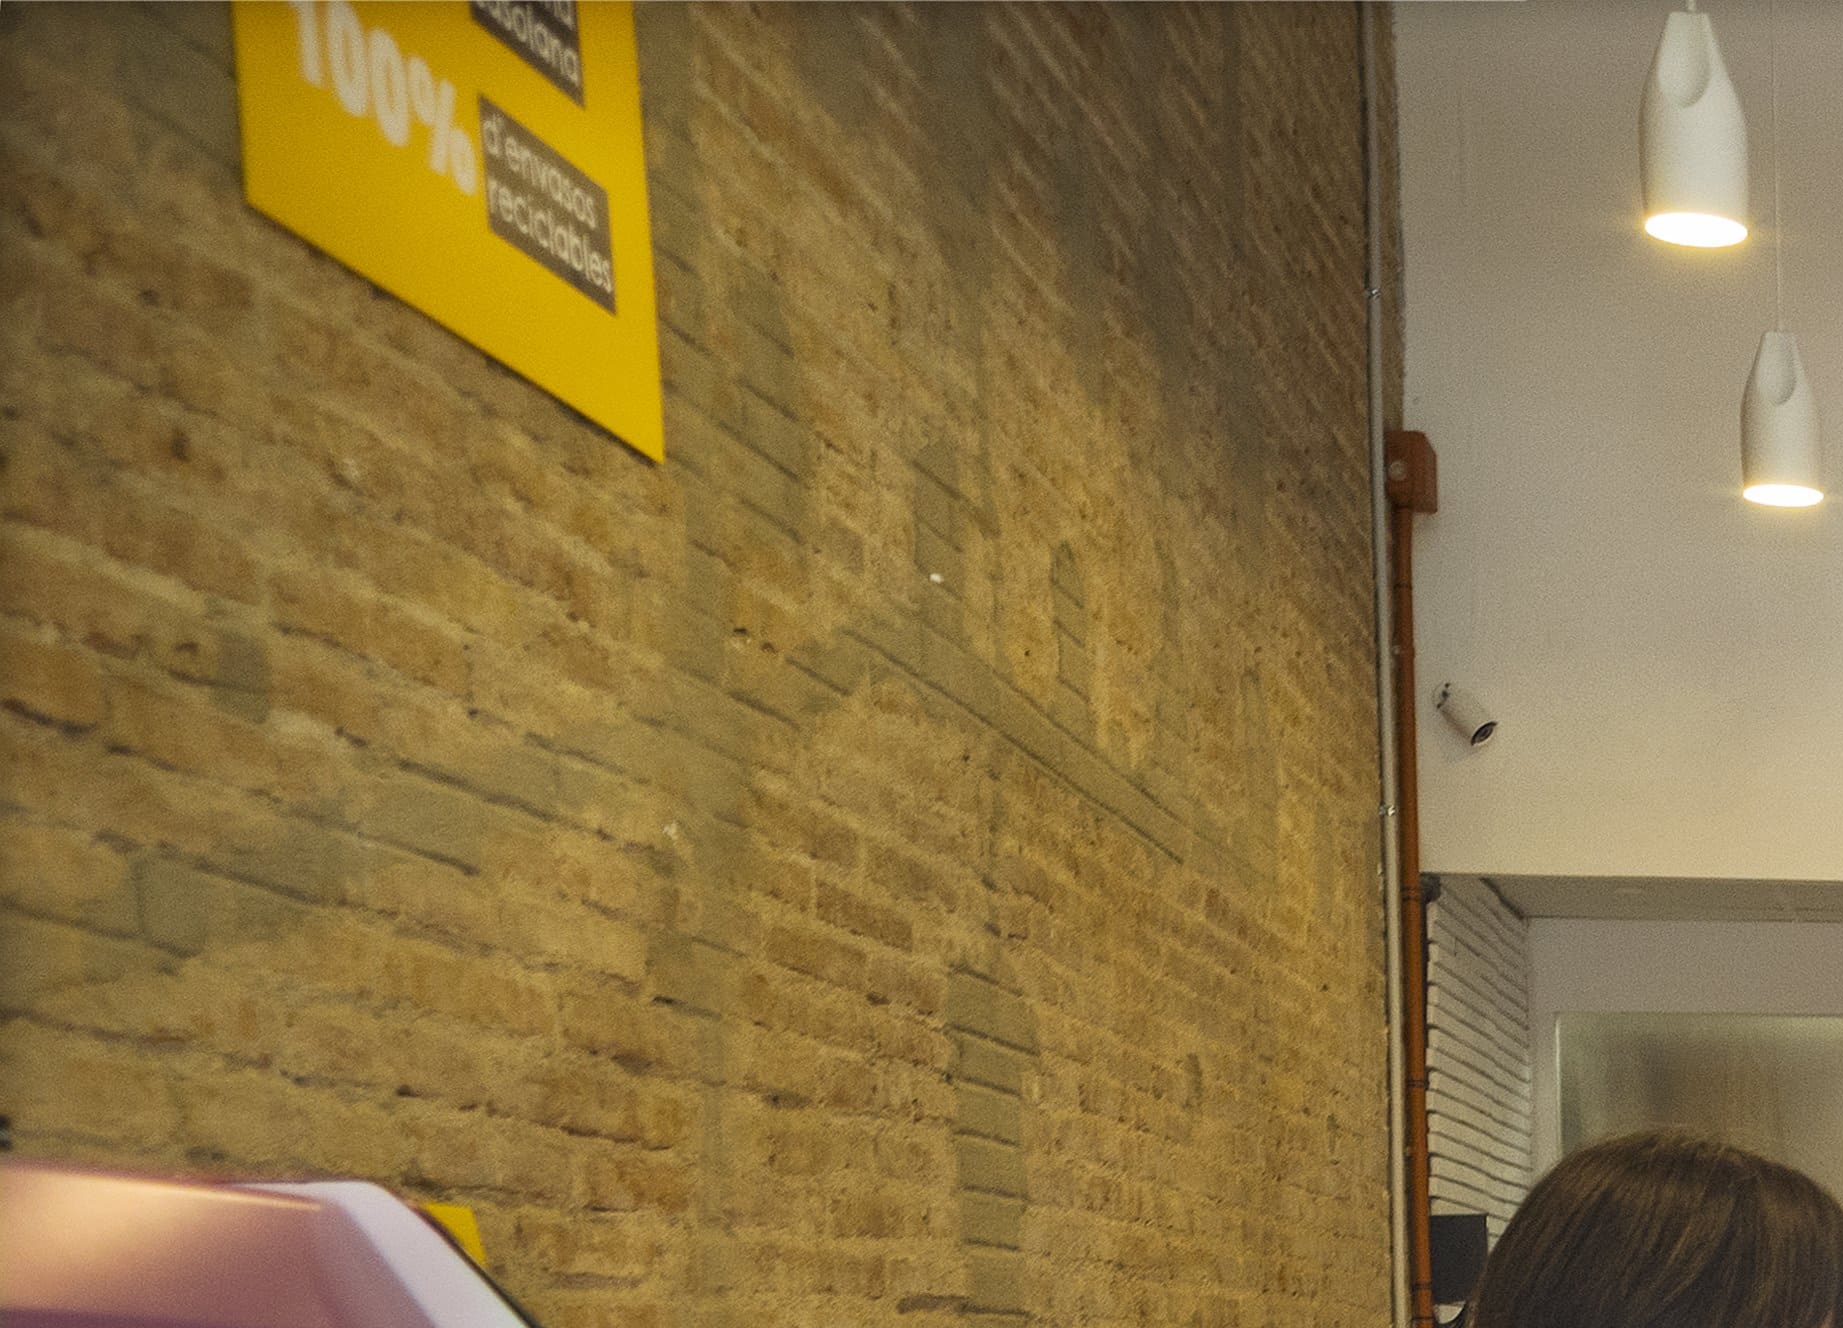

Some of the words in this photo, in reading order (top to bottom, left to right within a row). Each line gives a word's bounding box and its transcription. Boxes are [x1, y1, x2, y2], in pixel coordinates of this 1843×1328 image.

[289, 0, 477, 196] 100%
[481, 114, 597, 230] d'envasos
[487, 181, 613, 295] reciclables
